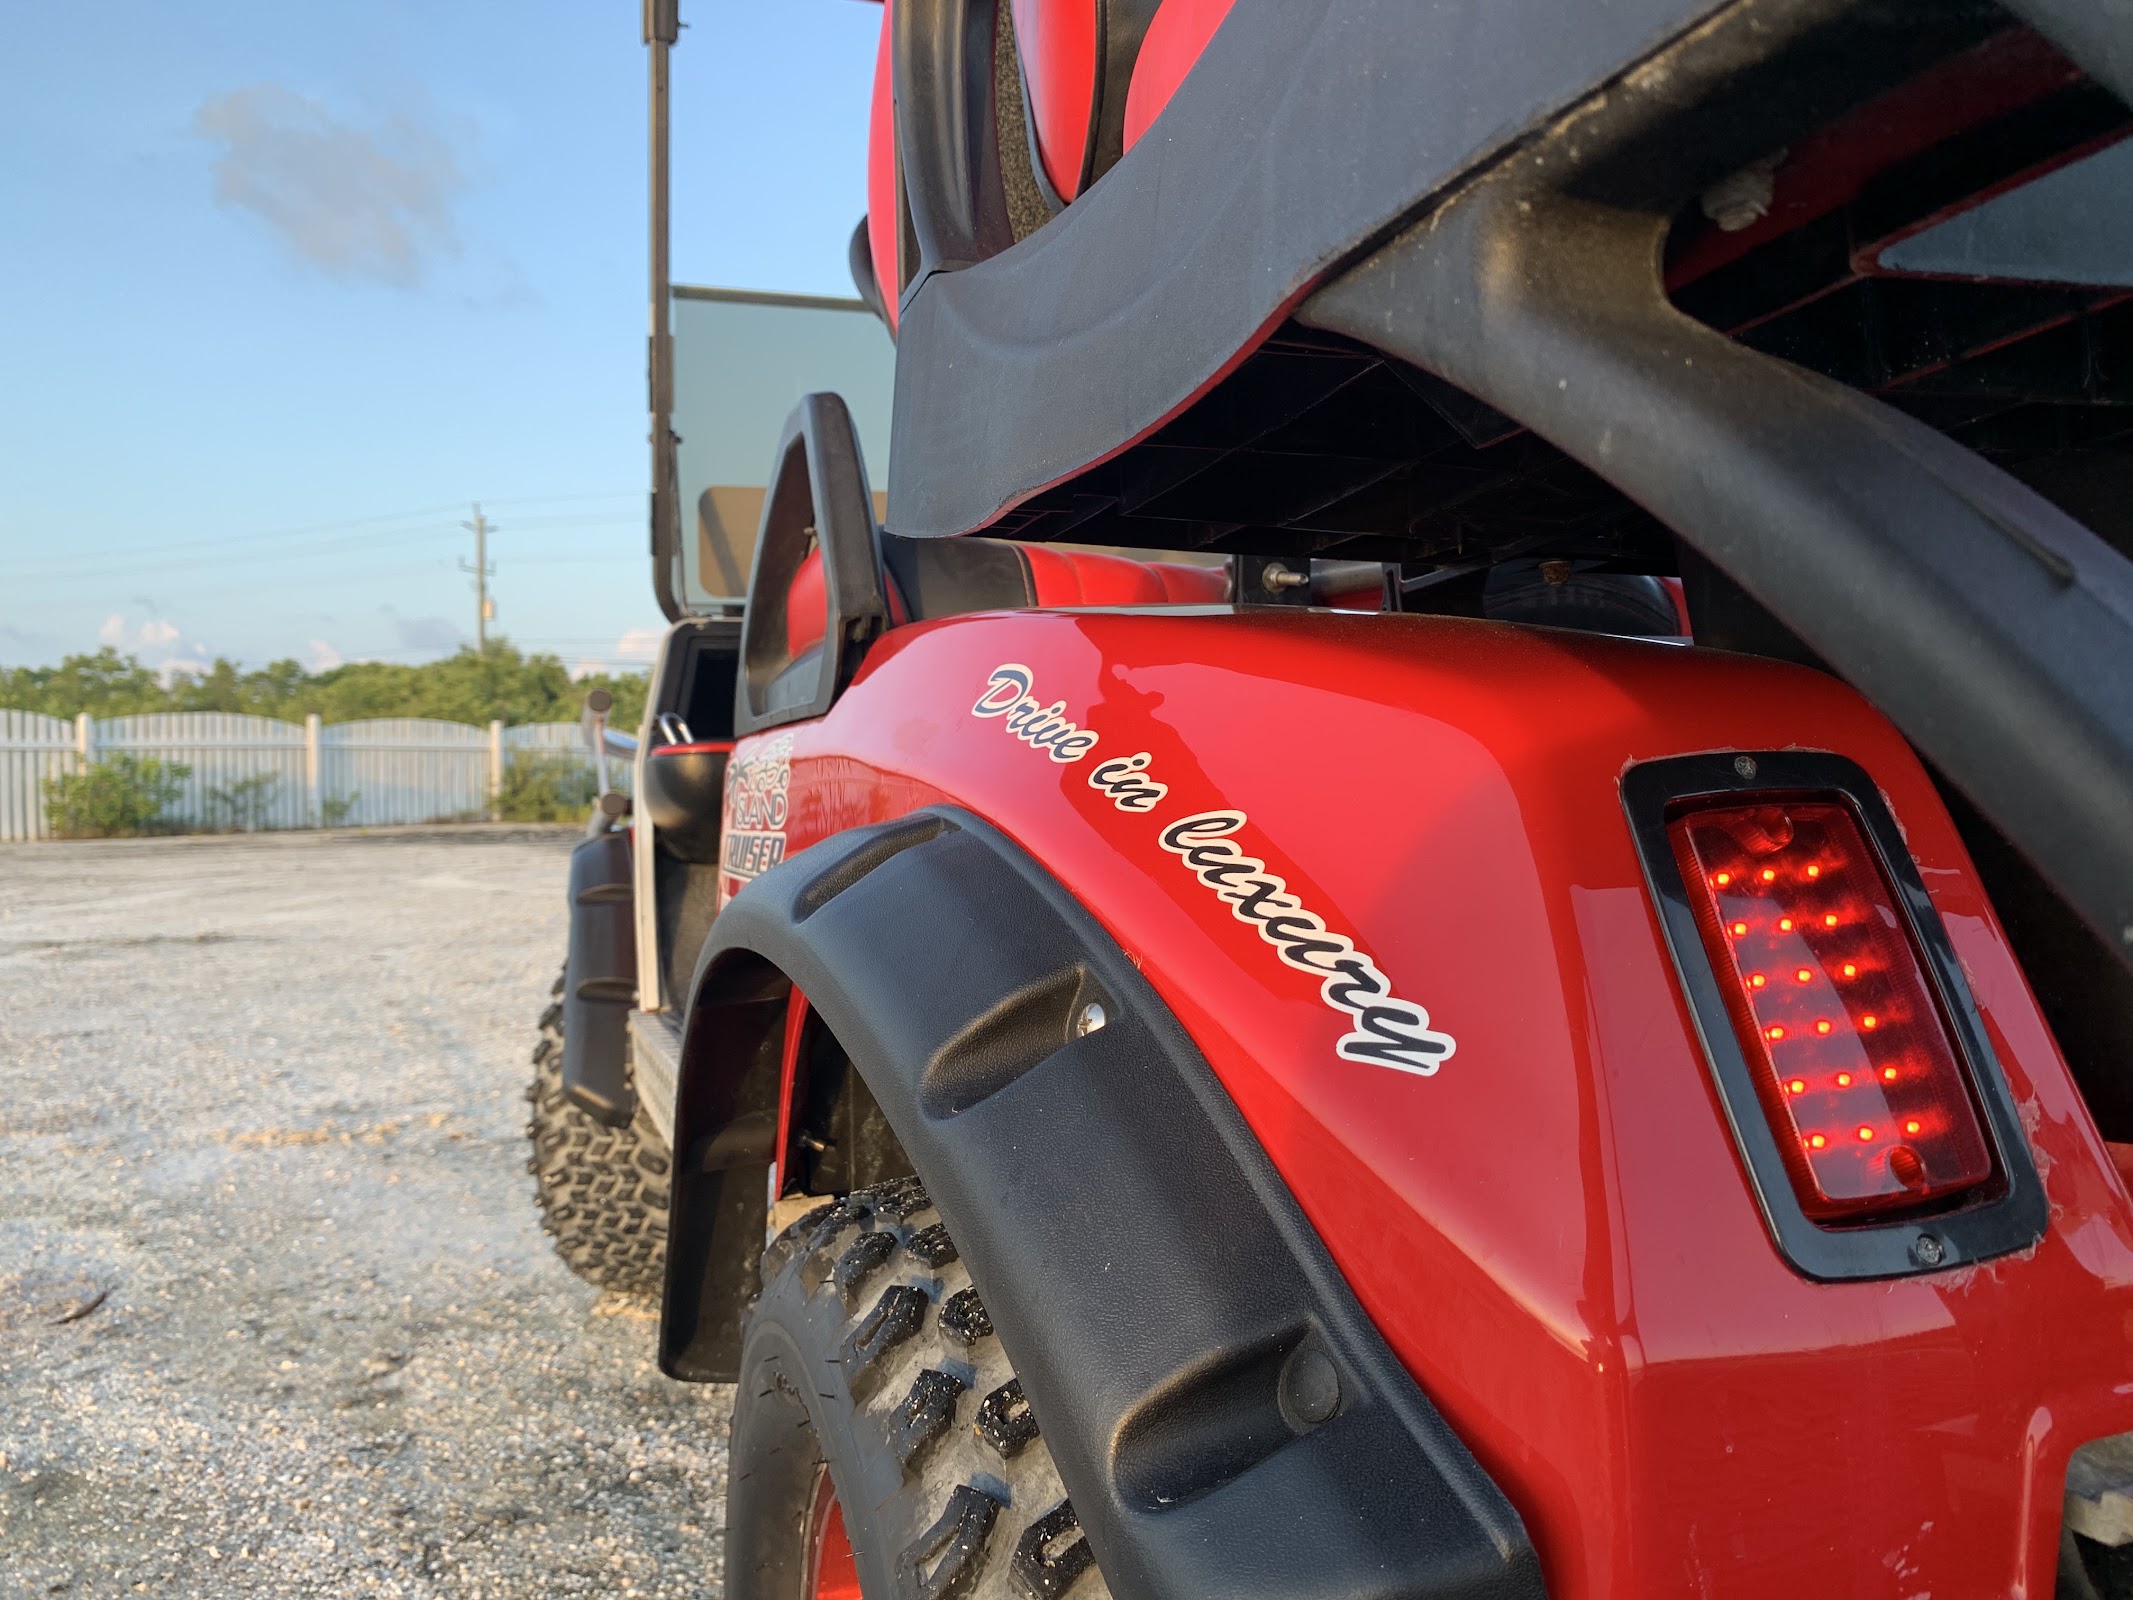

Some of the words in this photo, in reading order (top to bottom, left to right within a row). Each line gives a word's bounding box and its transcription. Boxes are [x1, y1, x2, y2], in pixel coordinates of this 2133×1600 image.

[733, 791, 787, 829] ISLAND
[973, 667, 1093, 760] Drive
[1091, 757, 1162, 809] in
[1164, 816, 1448, 1071] luxury
